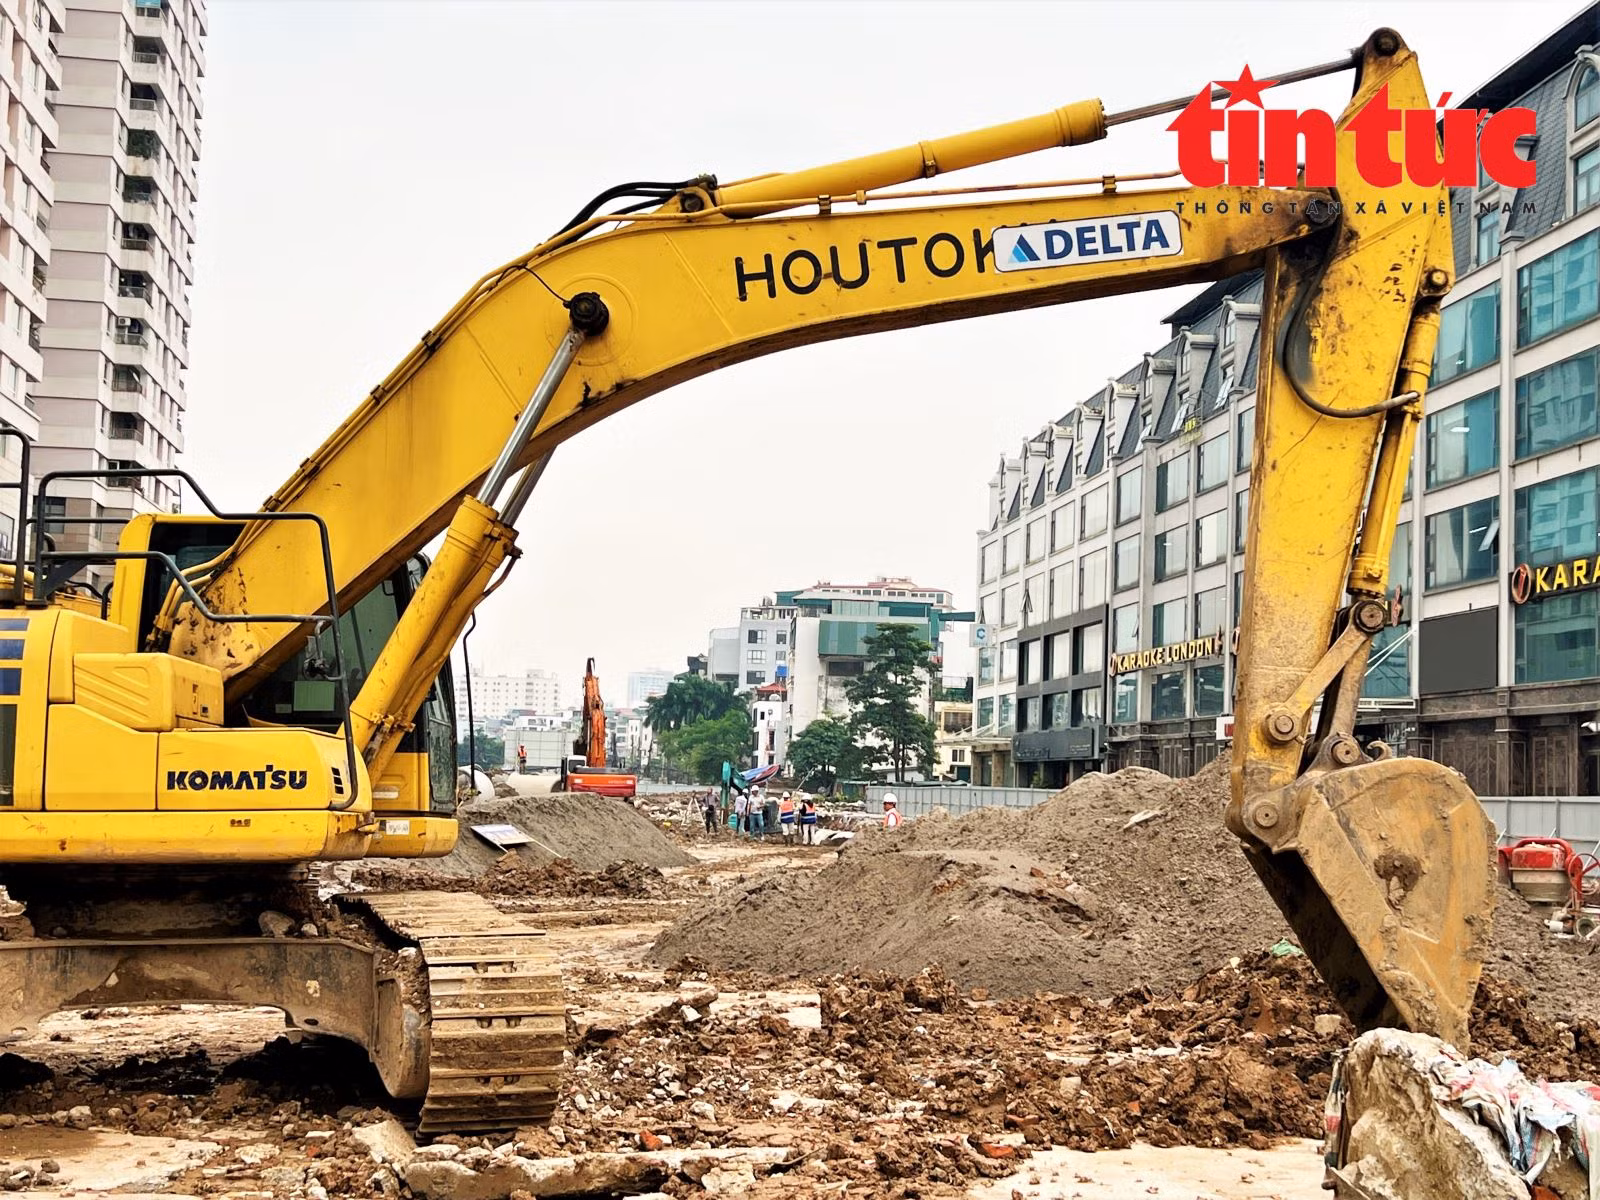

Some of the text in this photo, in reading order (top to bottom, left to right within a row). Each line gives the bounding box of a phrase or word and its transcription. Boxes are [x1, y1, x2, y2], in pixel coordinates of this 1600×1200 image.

[1044, 218, 1170, 260] DELTA
[735, 219, 1056, 301] HOUTOK
[1117, 637, 1213, 672] KARAOKE LONDON
[166, 764, 308, 791] KOMATSU
